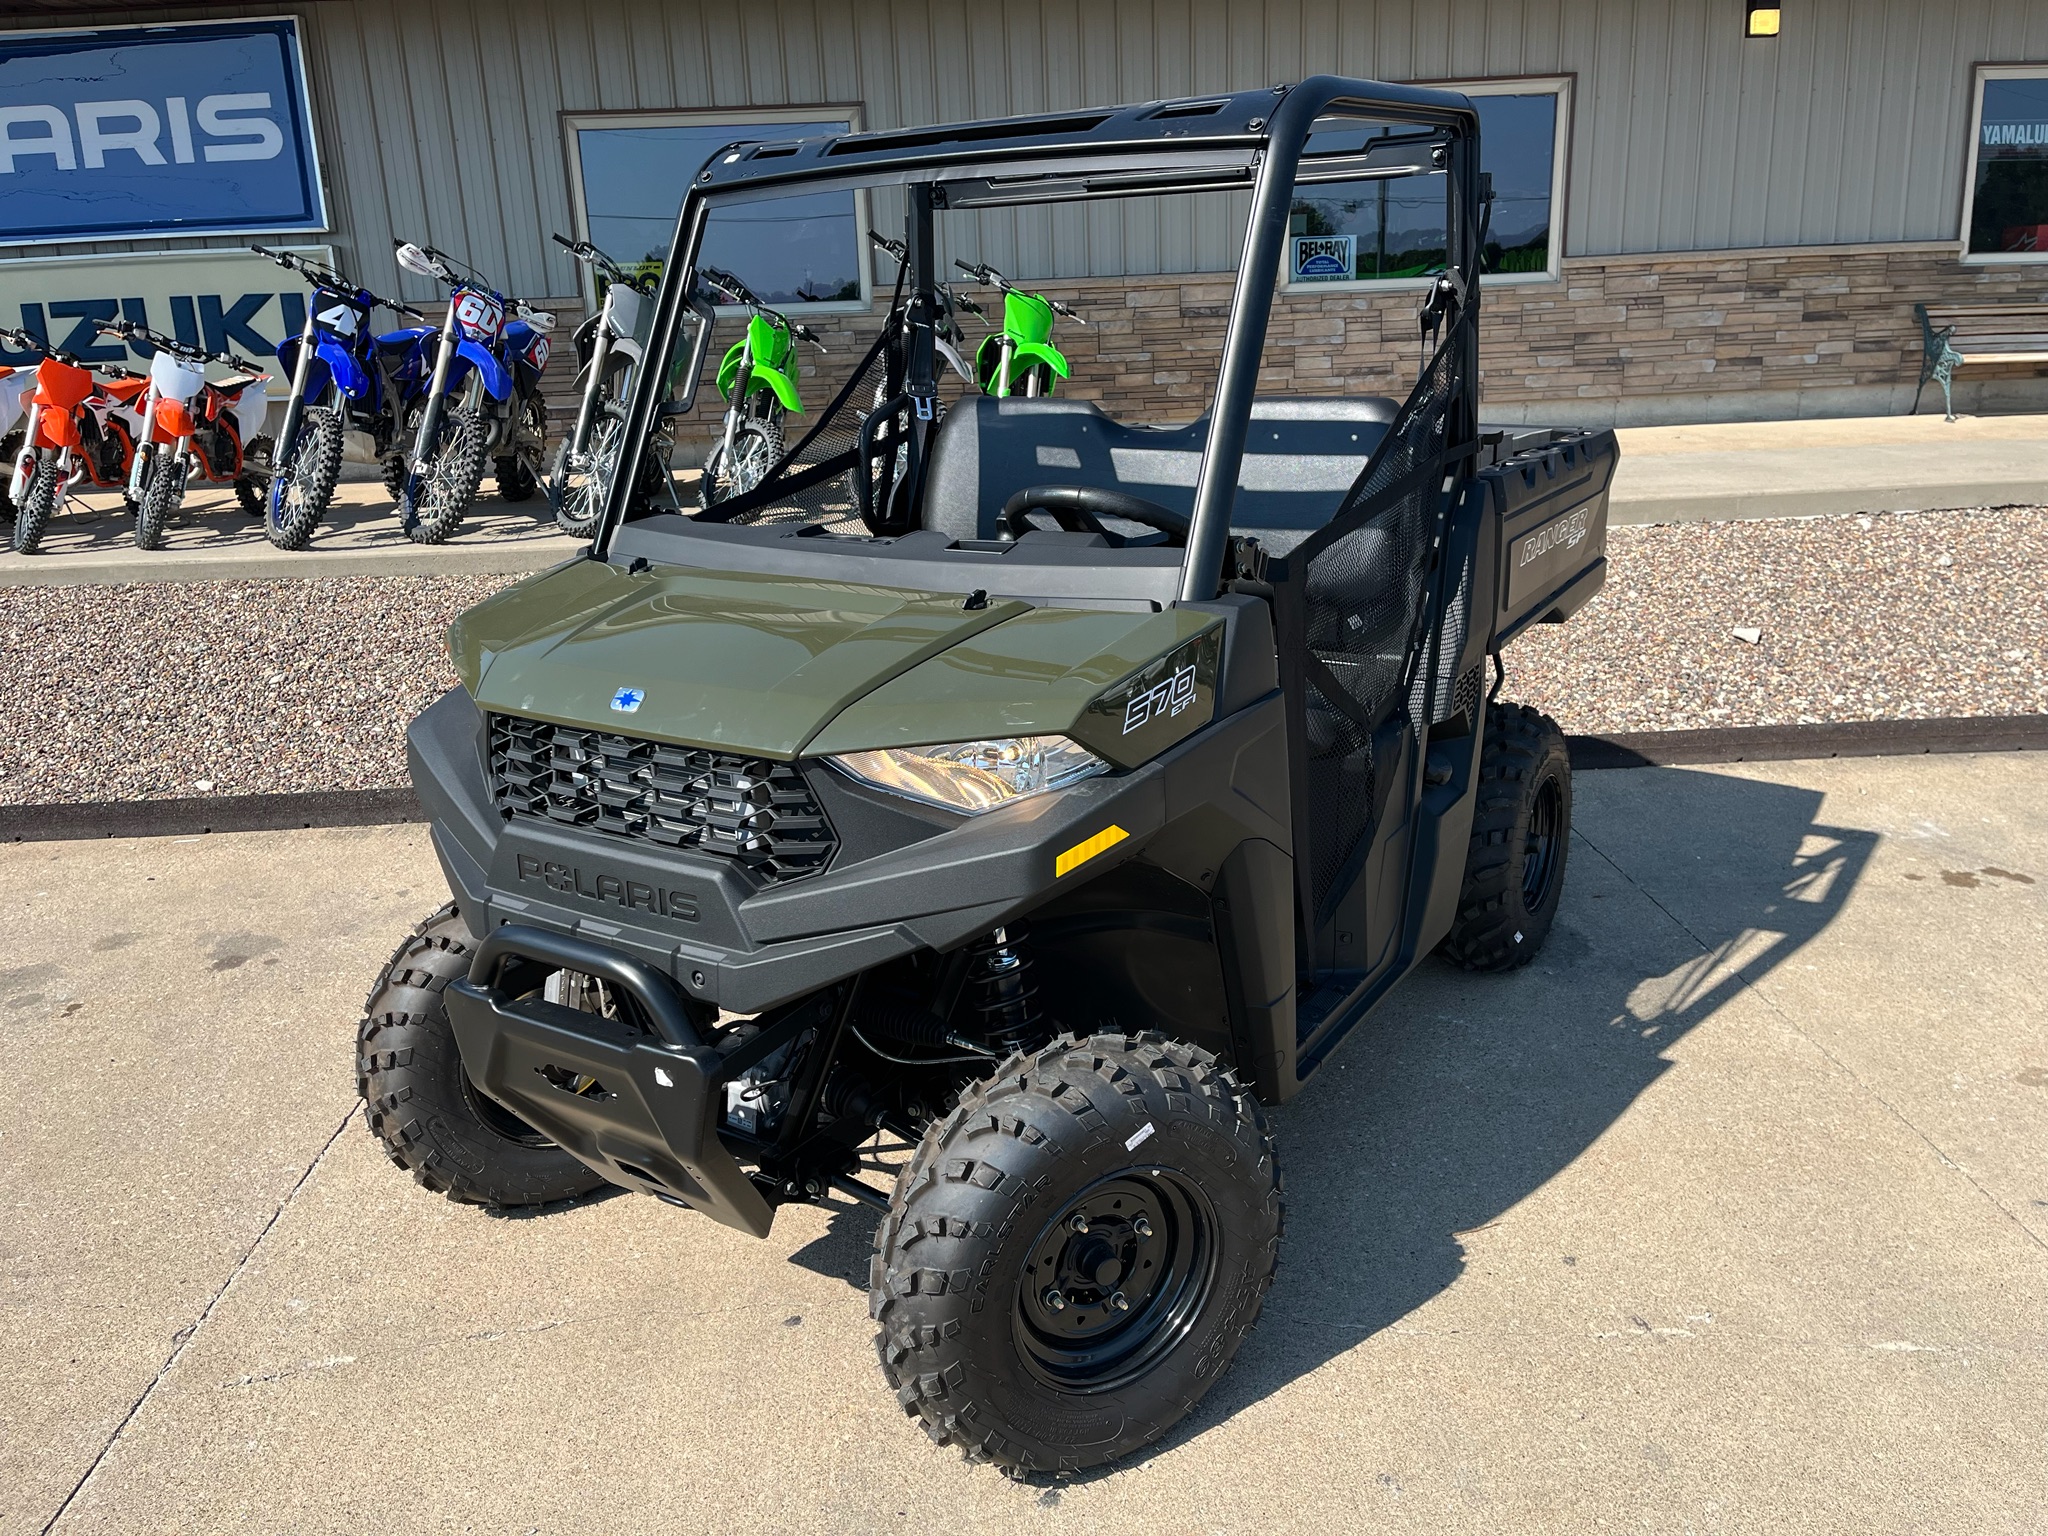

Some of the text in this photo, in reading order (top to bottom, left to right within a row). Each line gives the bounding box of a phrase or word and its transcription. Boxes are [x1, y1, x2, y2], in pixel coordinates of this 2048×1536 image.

[0, 92, 283, 174] ARIS
[1983, 124, 2048, 145] YAMALU
[316, 303, 364, 337] 4
[456, 294, 503, 334] 60
[534, 338, 550, 370] 60
[1520, 507, 1588, 567] RANGER
[1566, 528, 1587, 549] SP
[1122, 664, 1196, 735] 570
[1170, 693, 1197, 718] EFI
[516, 853, 702, 925] POLARIS
[970, 1173, 1053, 1314] CARLSTAR
